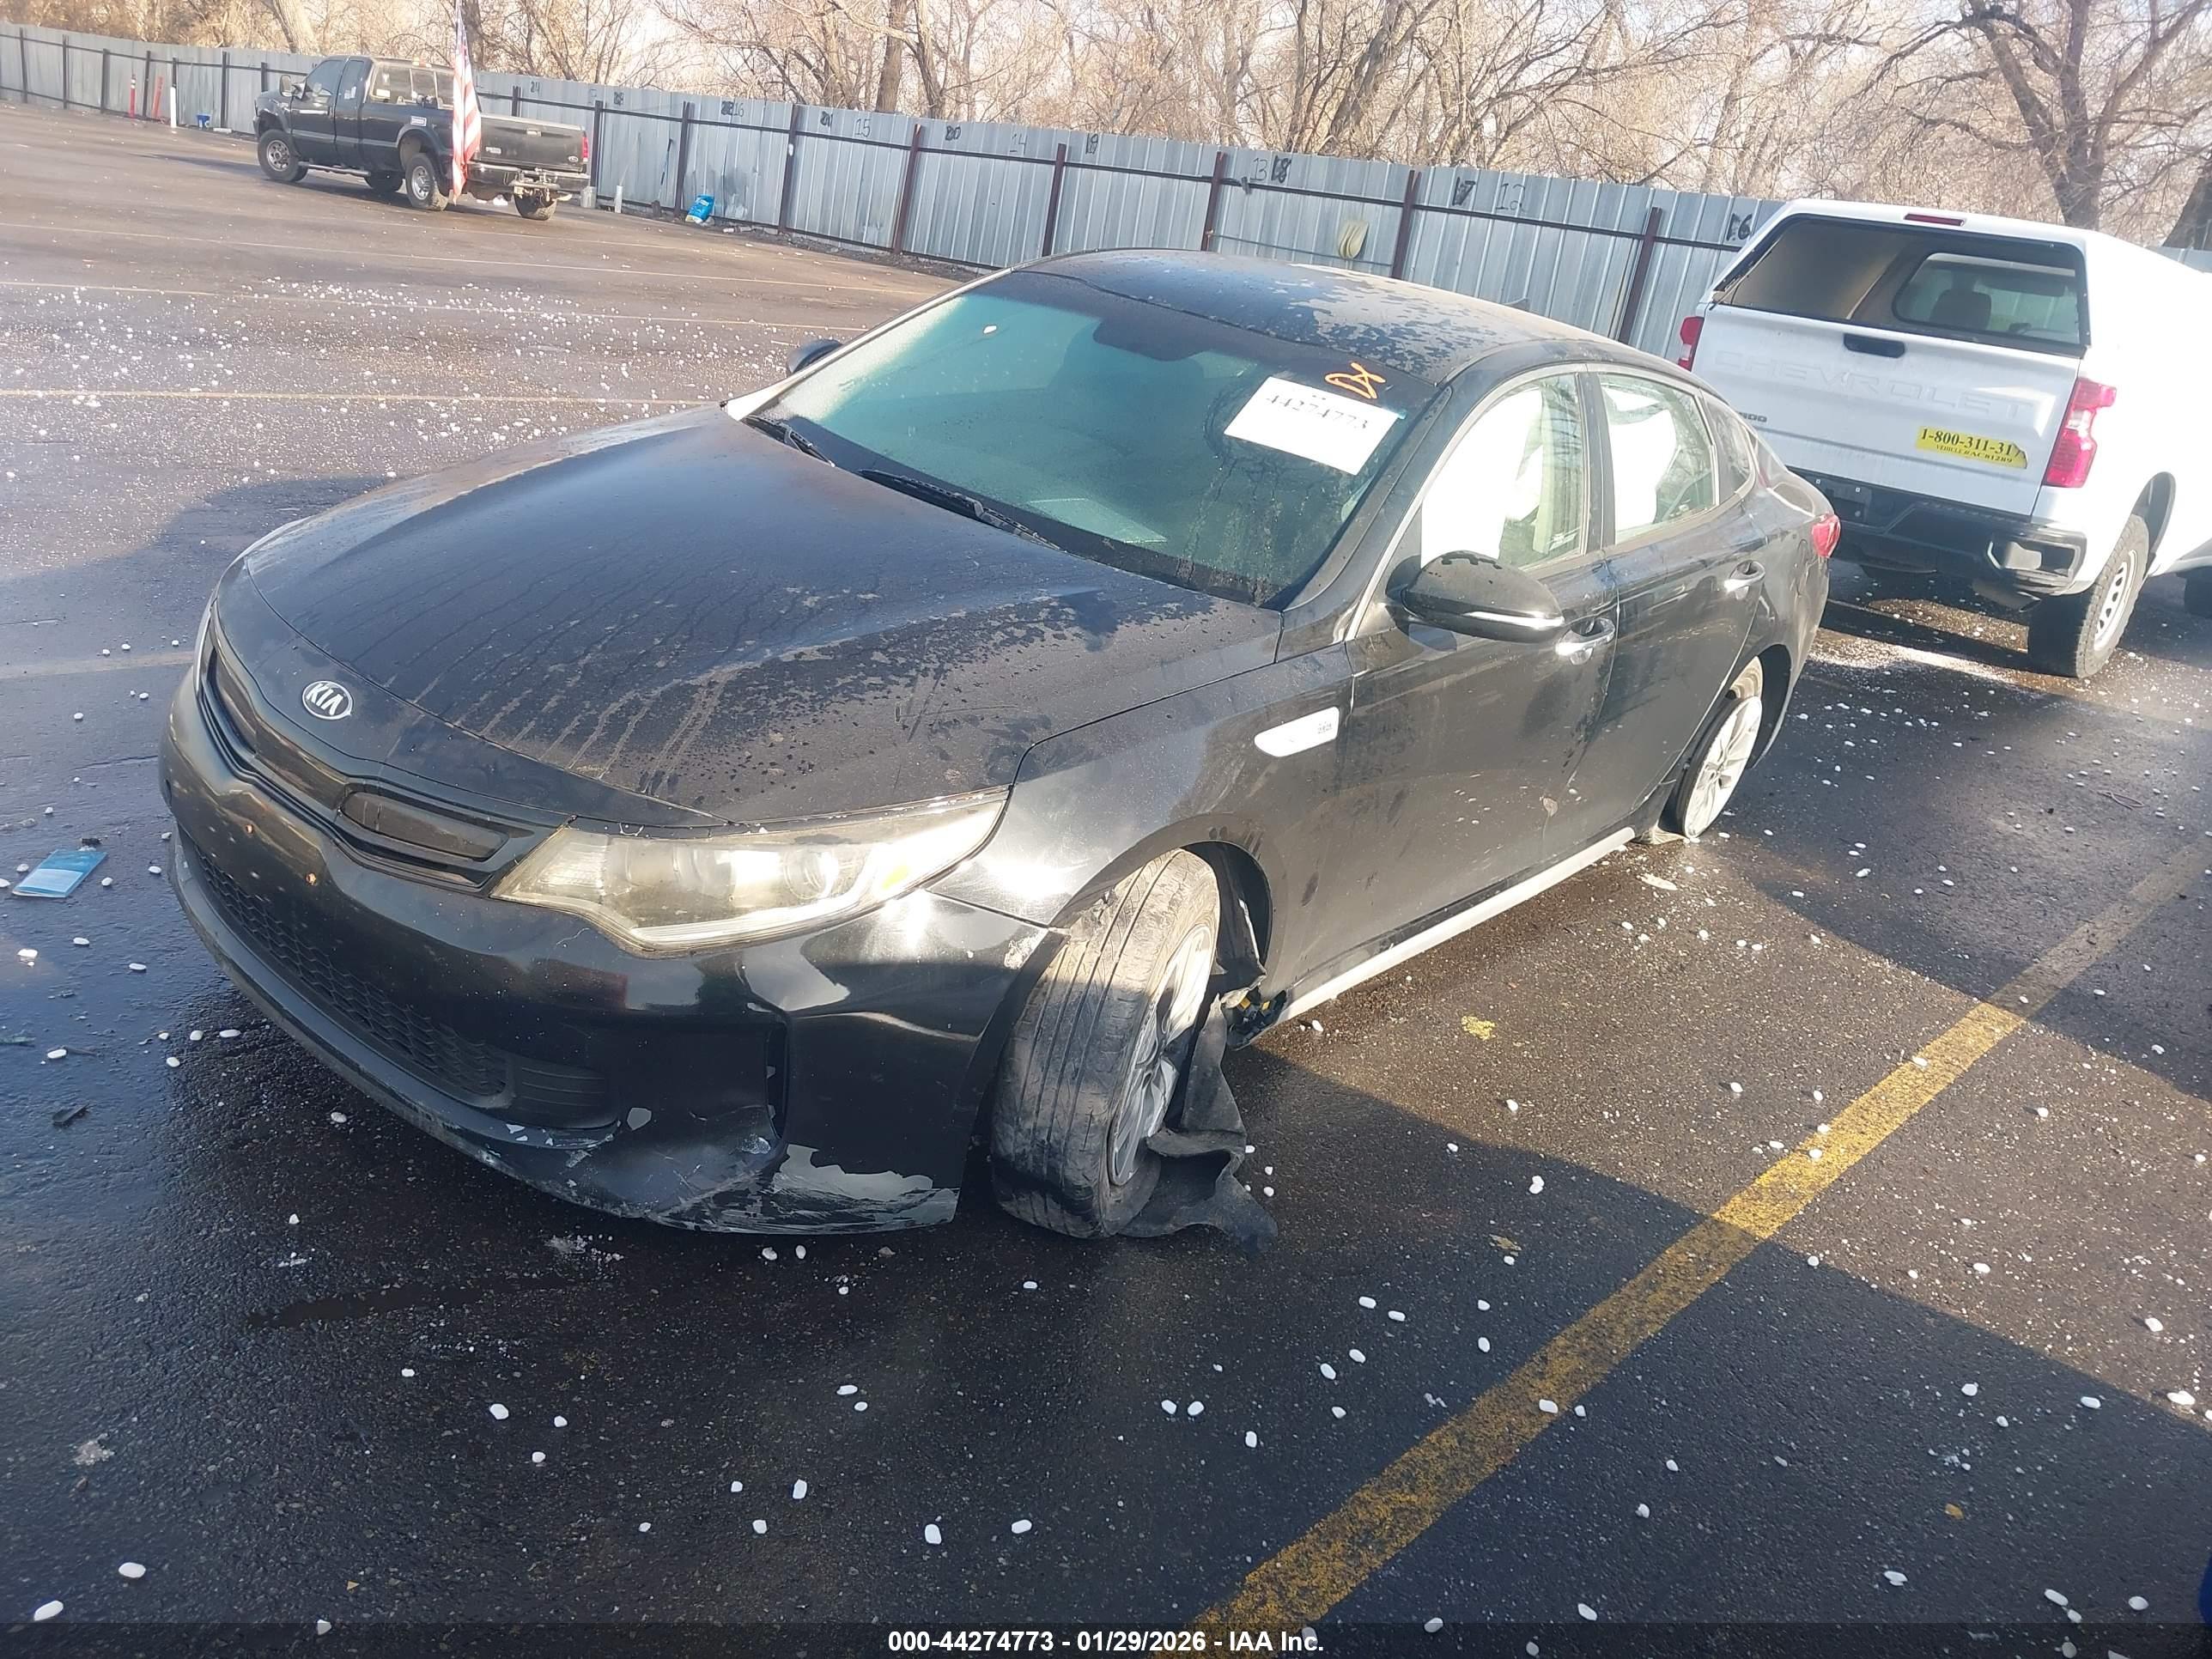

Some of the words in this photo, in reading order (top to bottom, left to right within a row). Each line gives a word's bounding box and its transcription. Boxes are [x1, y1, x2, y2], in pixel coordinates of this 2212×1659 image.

[854, 118, 872, 137] 15
[1250, 157, 1267, 180] 13
[1495, 183, 1526, 212] 12
[1717, 350, 2035, 420] CHEVROLET
[306, 683, 344, 715] KIA
